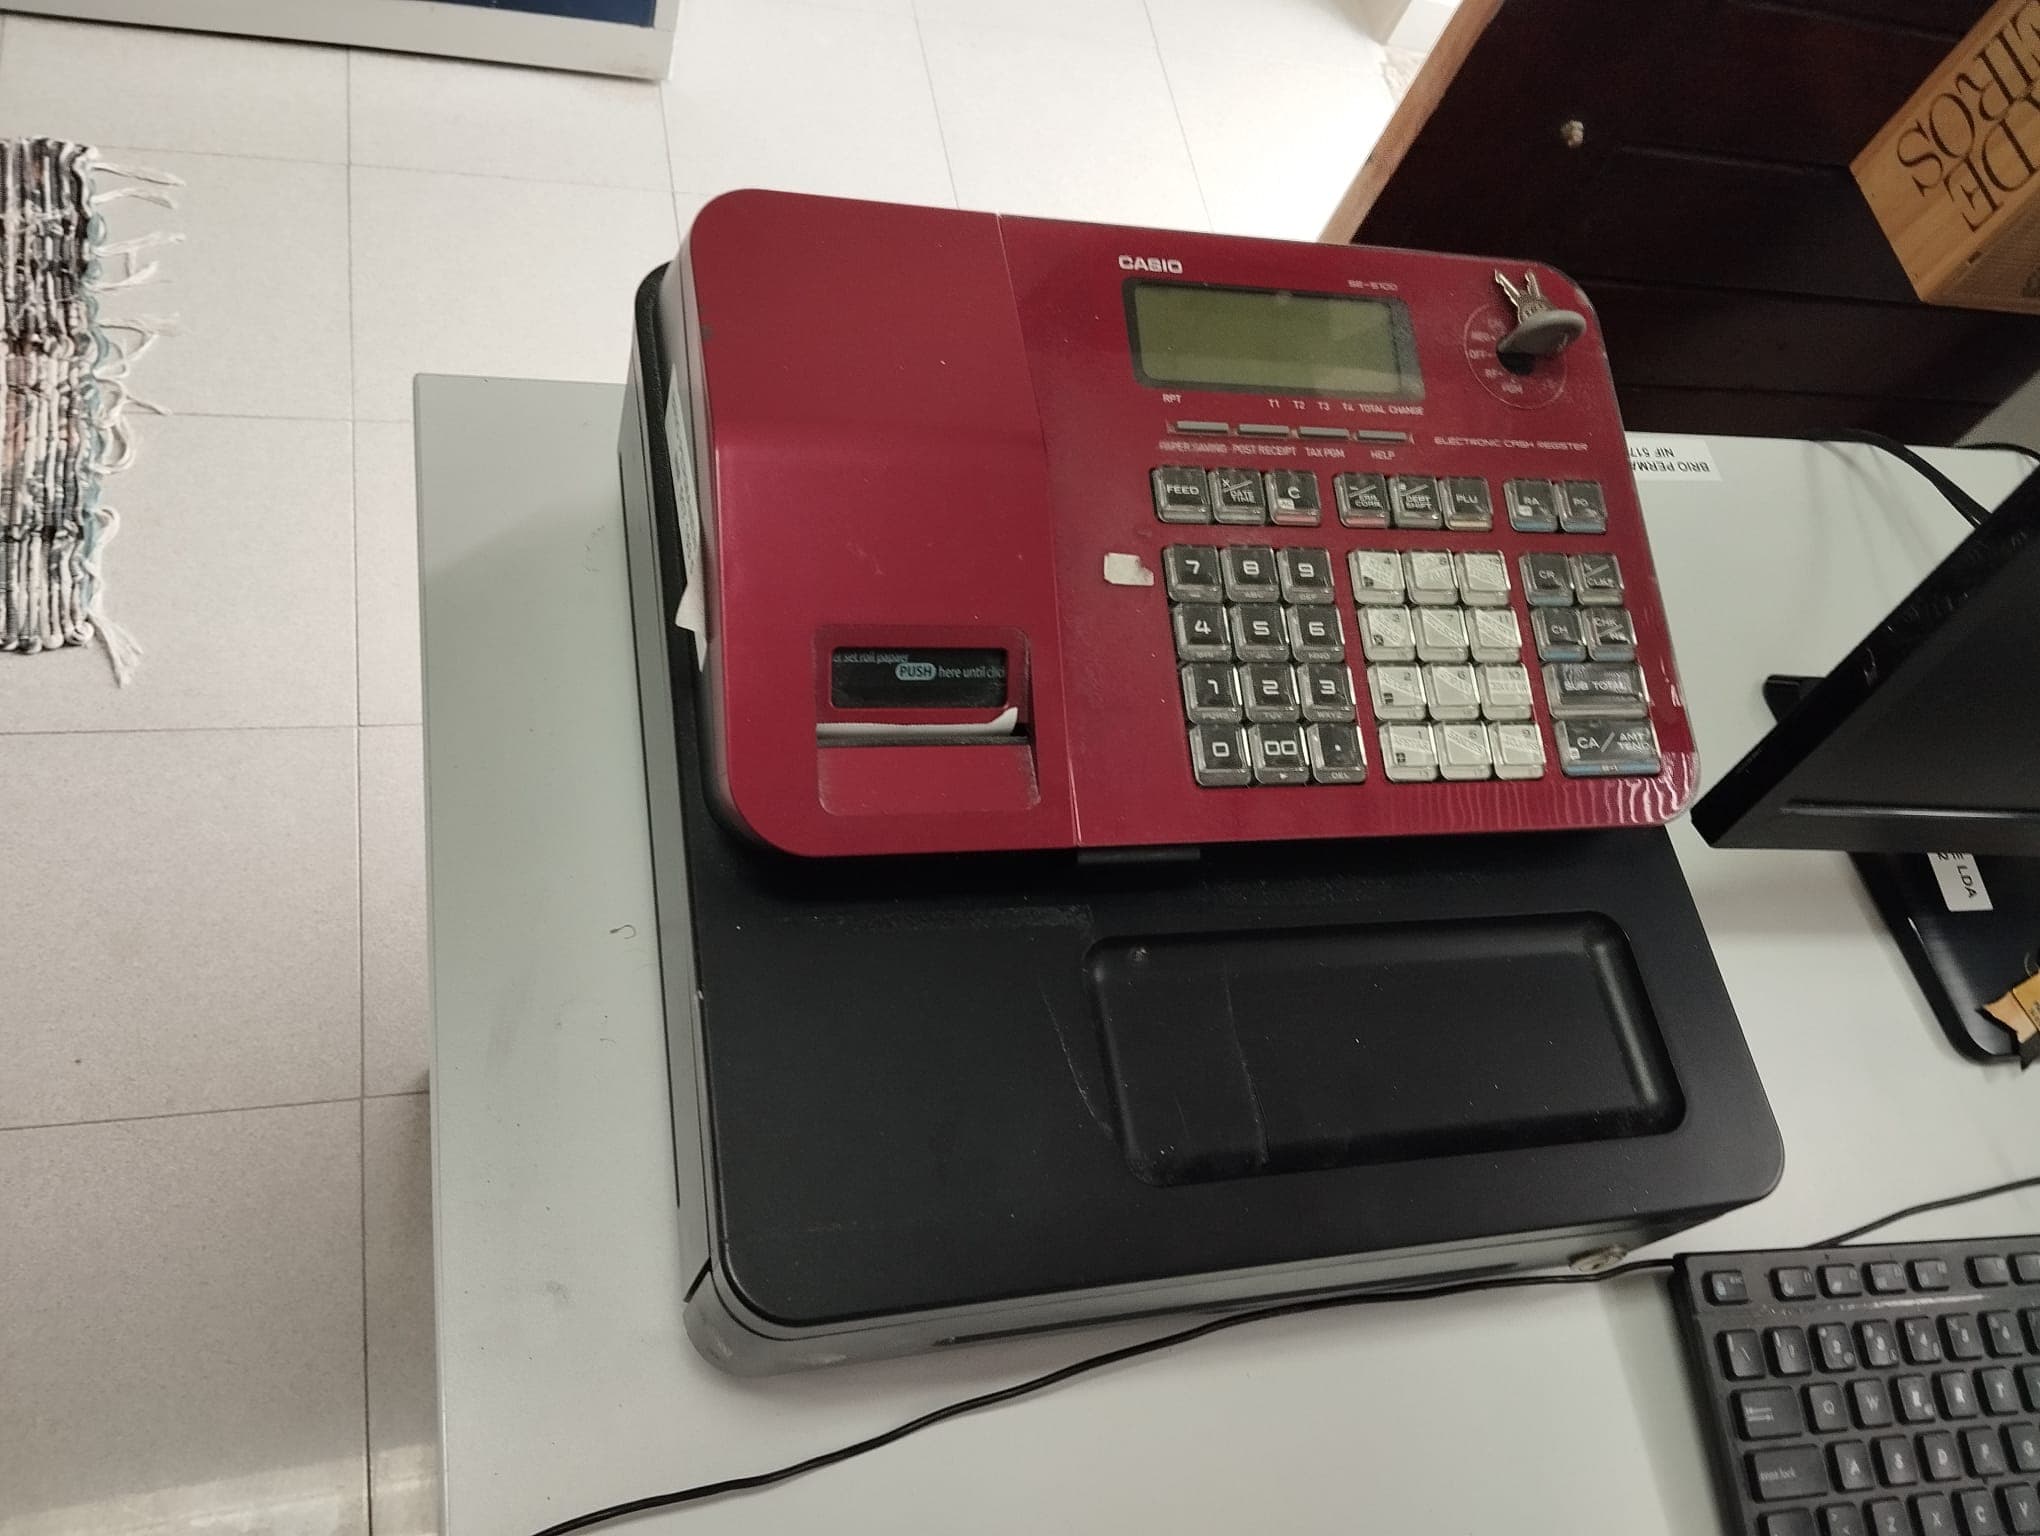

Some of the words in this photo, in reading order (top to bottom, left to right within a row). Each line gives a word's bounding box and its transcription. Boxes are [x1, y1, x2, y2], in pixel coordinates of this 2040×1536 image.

[1118, 254, 1183, 275] CASIO
[1162, 393, 1182, 404] RPT
[1268, 398, 1280, 409] T1
[1293, 400, 1306, 410] T2
[1318, 401, 1330, 411] T3
[1359, 403, 1386, 415] TOTAL
[1388, 405, 1424, 416] CHANGE
[1232, 444, 1257, 456] POST
[1258, 445, 1297, 457] RECEIPT
[1434, 436, 1500, 448] ELECTRONIC
[1537, 440, 1588, 451] REGISTER
[1306, 446, 1324, 458] TAX
[1370, 449, 1396, 460] HELP
[1656, 447, 1675, 458] NIF
[1677, 461, 1711, 473] BRIO
[1166, 484, 1199, 496] FEED
[1287, 486, 1301, 499] C
[1456, 493, 1478, 504] PLU
[1185, 560, 1200, 575] 7
[1243, 560, 1260, 575] 8
[1298, 563, 1315, 578] 9
[1194, 619, 1212, 635] 4
[1252, 620, 1271, 636] 5
[1308, 621, 1326, 637] 6
[900, 666, 933, 677] PUSH
[938, 665, 961, 678] here
[962, 666, 986, 678] until
[1207, 679, 1219, 695] 1
[1262, 679, 1280, 695] 2
[1318, 679, 1336, 695] 3
[1576, 736, 1600, 749] CA
[1620, 732, 1645, 743] AMT
[1957, 865, 1977, 898] LDA
[1823, 1400, 1835, 1415] Q
[1866, 1395, 1879, 1411] W
[1937, 1448, 1948, 1465] D
[1975, 1505, 1986, 1523] C
[2019, 1501, 2029, 1518] V
[1932, 1511, 1943, 1528] X
